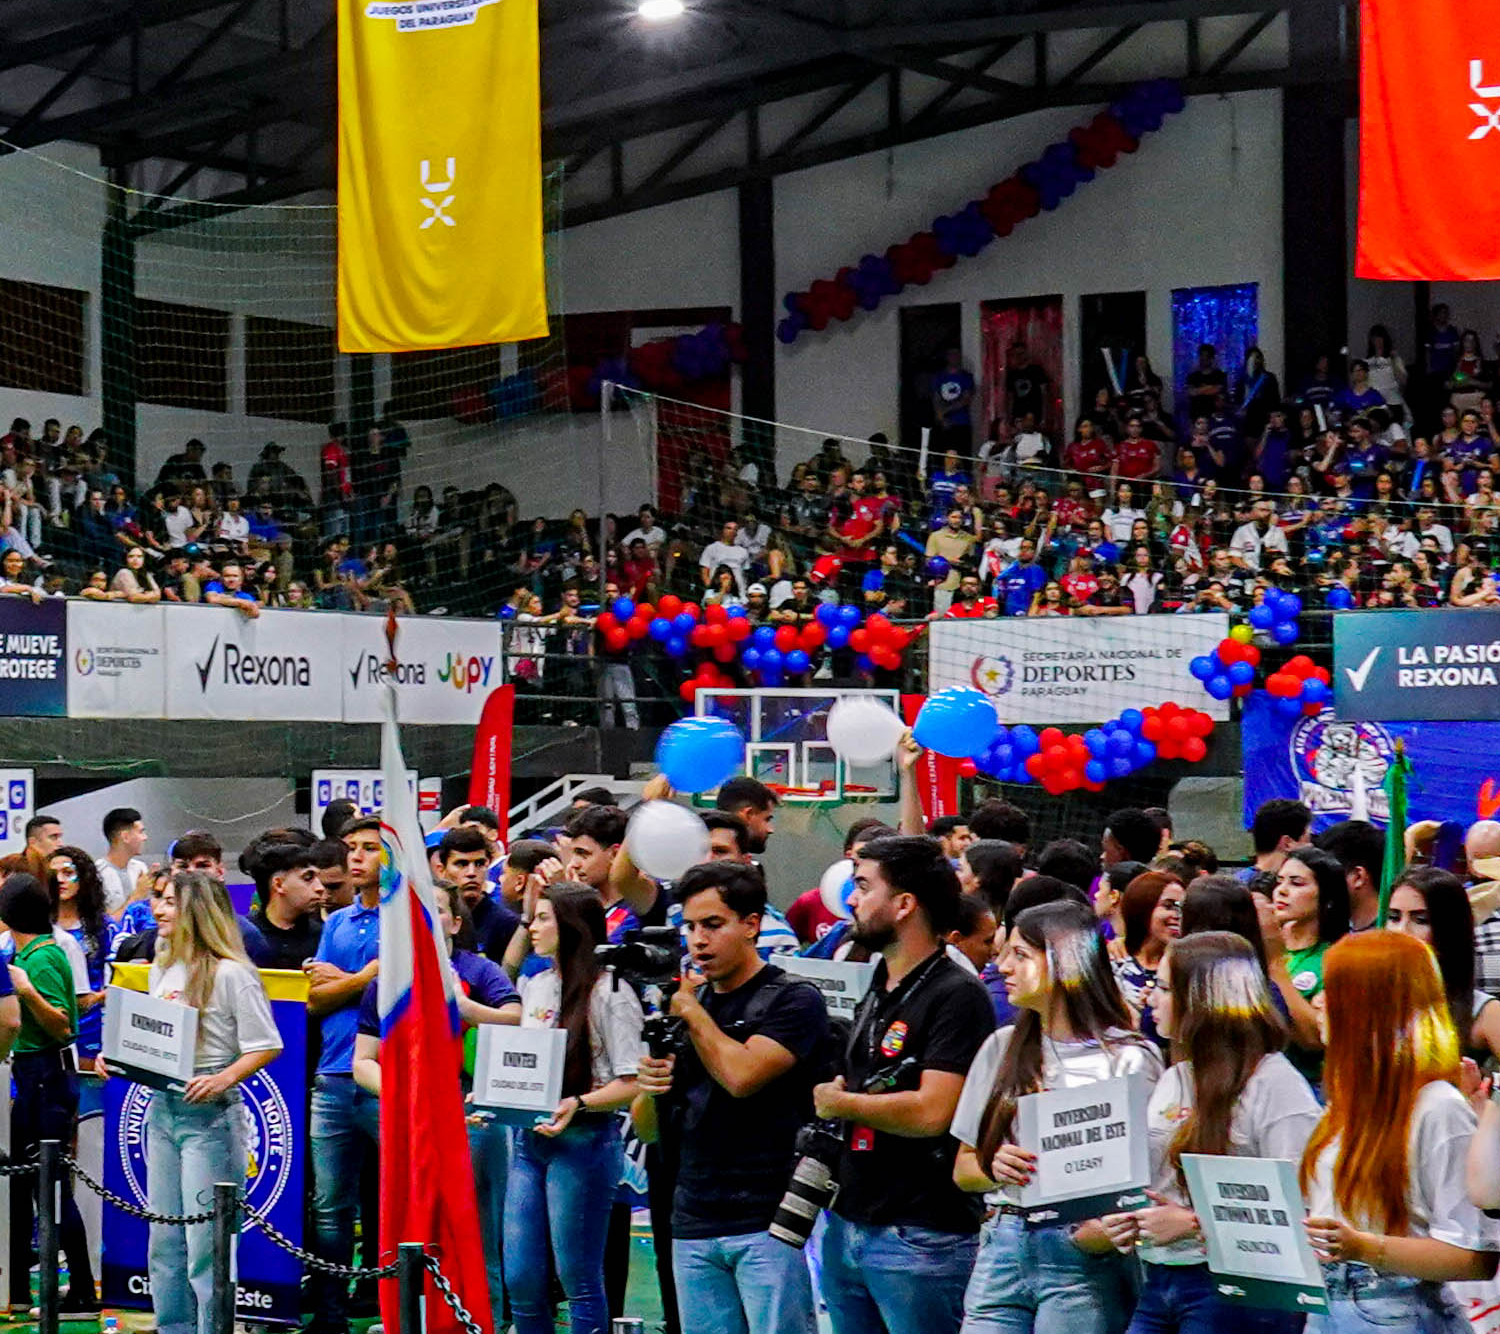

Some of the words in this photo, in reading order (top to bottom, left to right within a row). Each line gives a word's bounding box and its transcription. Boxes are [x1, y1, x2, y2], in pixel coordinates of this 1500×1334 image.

[6, 634, 62, 657] MUEVE,
[1022, 651, 1095, 662] SECRETARIA
[1100, 649, 1162, 661] NACIONAL
[1166, 648, 1183, 659] DE
[1398, 645, 1430, 665] LA
[223, 642, 312, 687] Rexona
[367, 654, 426, 685] Reona
[1022, 663, 1136, 684] DEPORTES
[1398, 667, 1495, 688] REXONA
[1021, 685, 1089, 696] PARAGUAY
[127, 1084, 153, 1145] UNIVER
[262, 1098, 284, 1156] NORTE
[1085, 1127, 1102, 1144] DEL
[1105, 1121, 1126, 1140] ESTE
